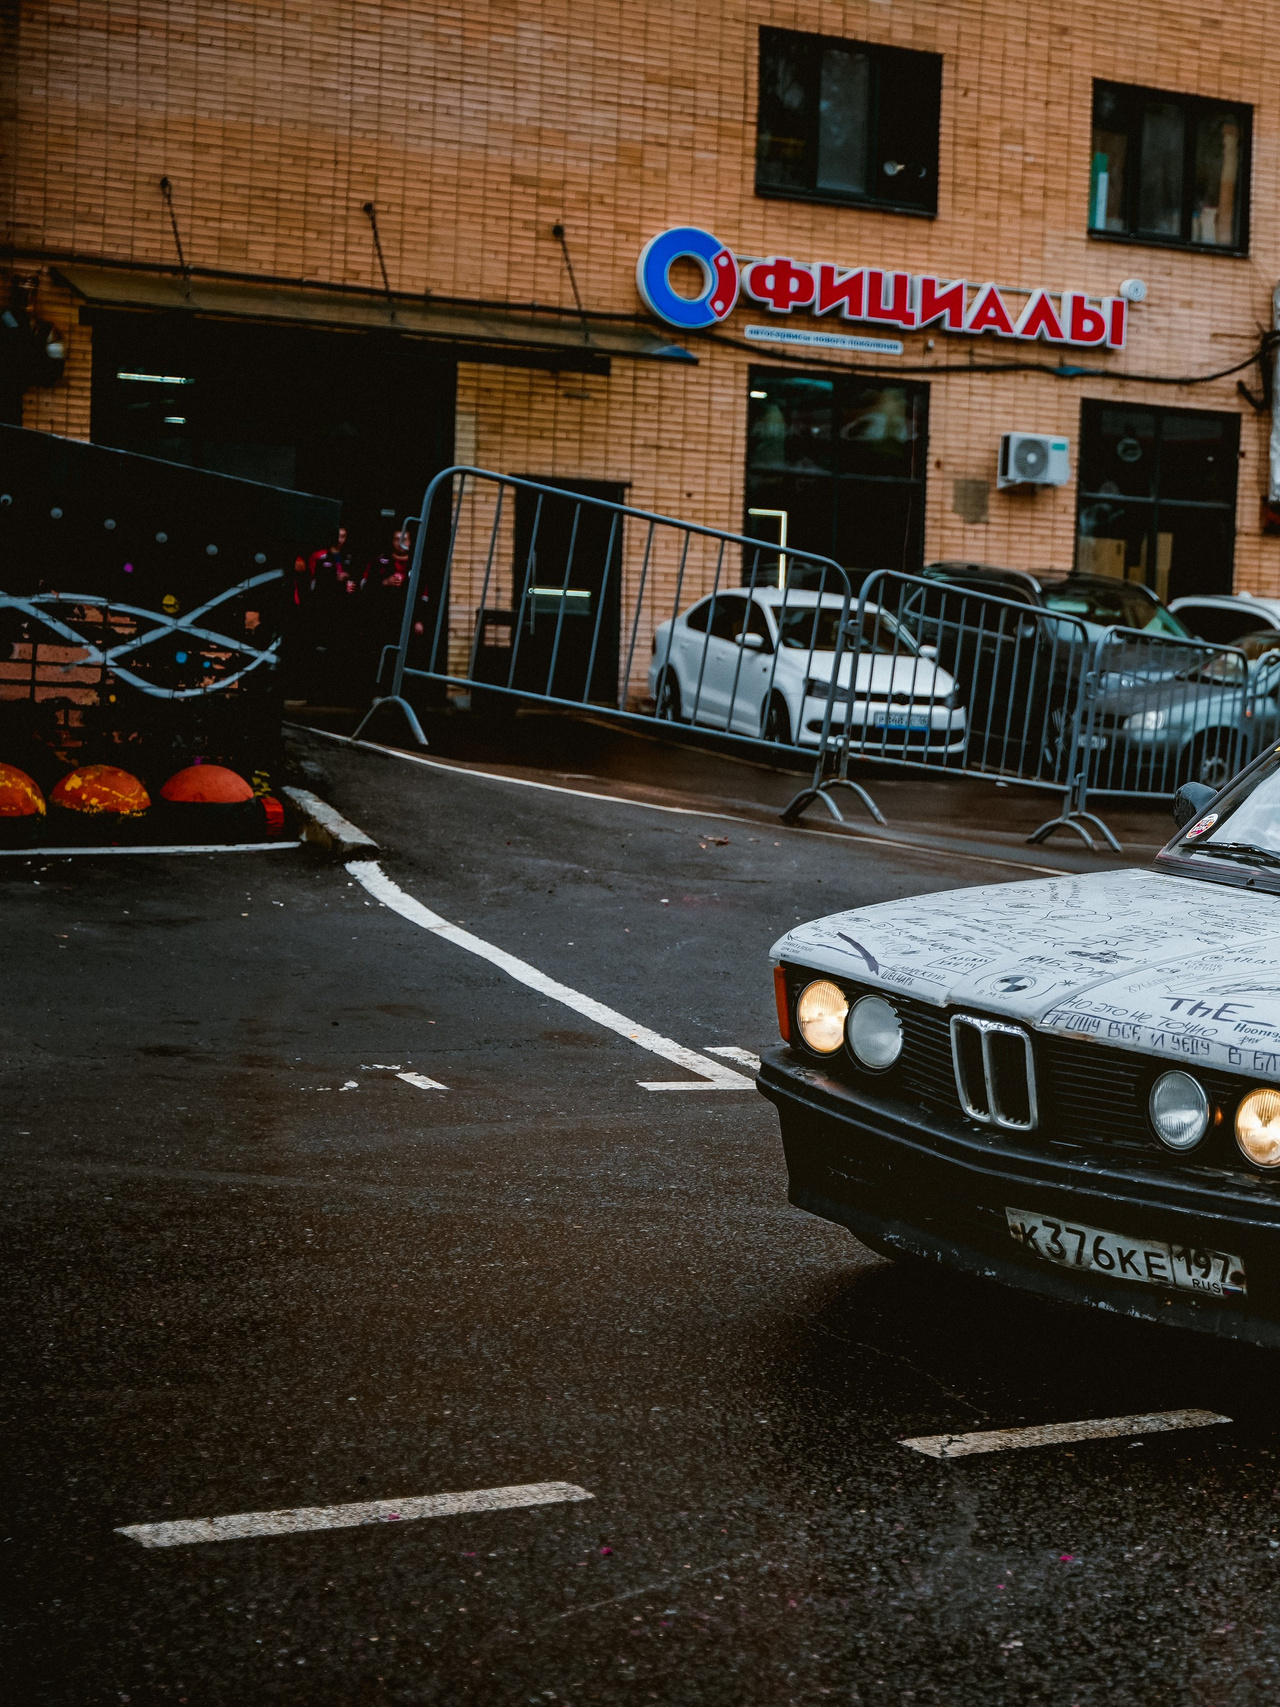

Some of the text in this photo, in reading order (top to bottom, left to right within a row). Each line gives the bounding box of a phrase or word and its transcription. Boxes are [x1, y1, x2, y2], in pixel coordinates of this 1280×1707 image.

[637, 226, 1129, 350] ОФИЦИАЛЫ
[1174, 1248, 1229, 1283] 197
[1192, 1278, 1221, 1294] RUS
